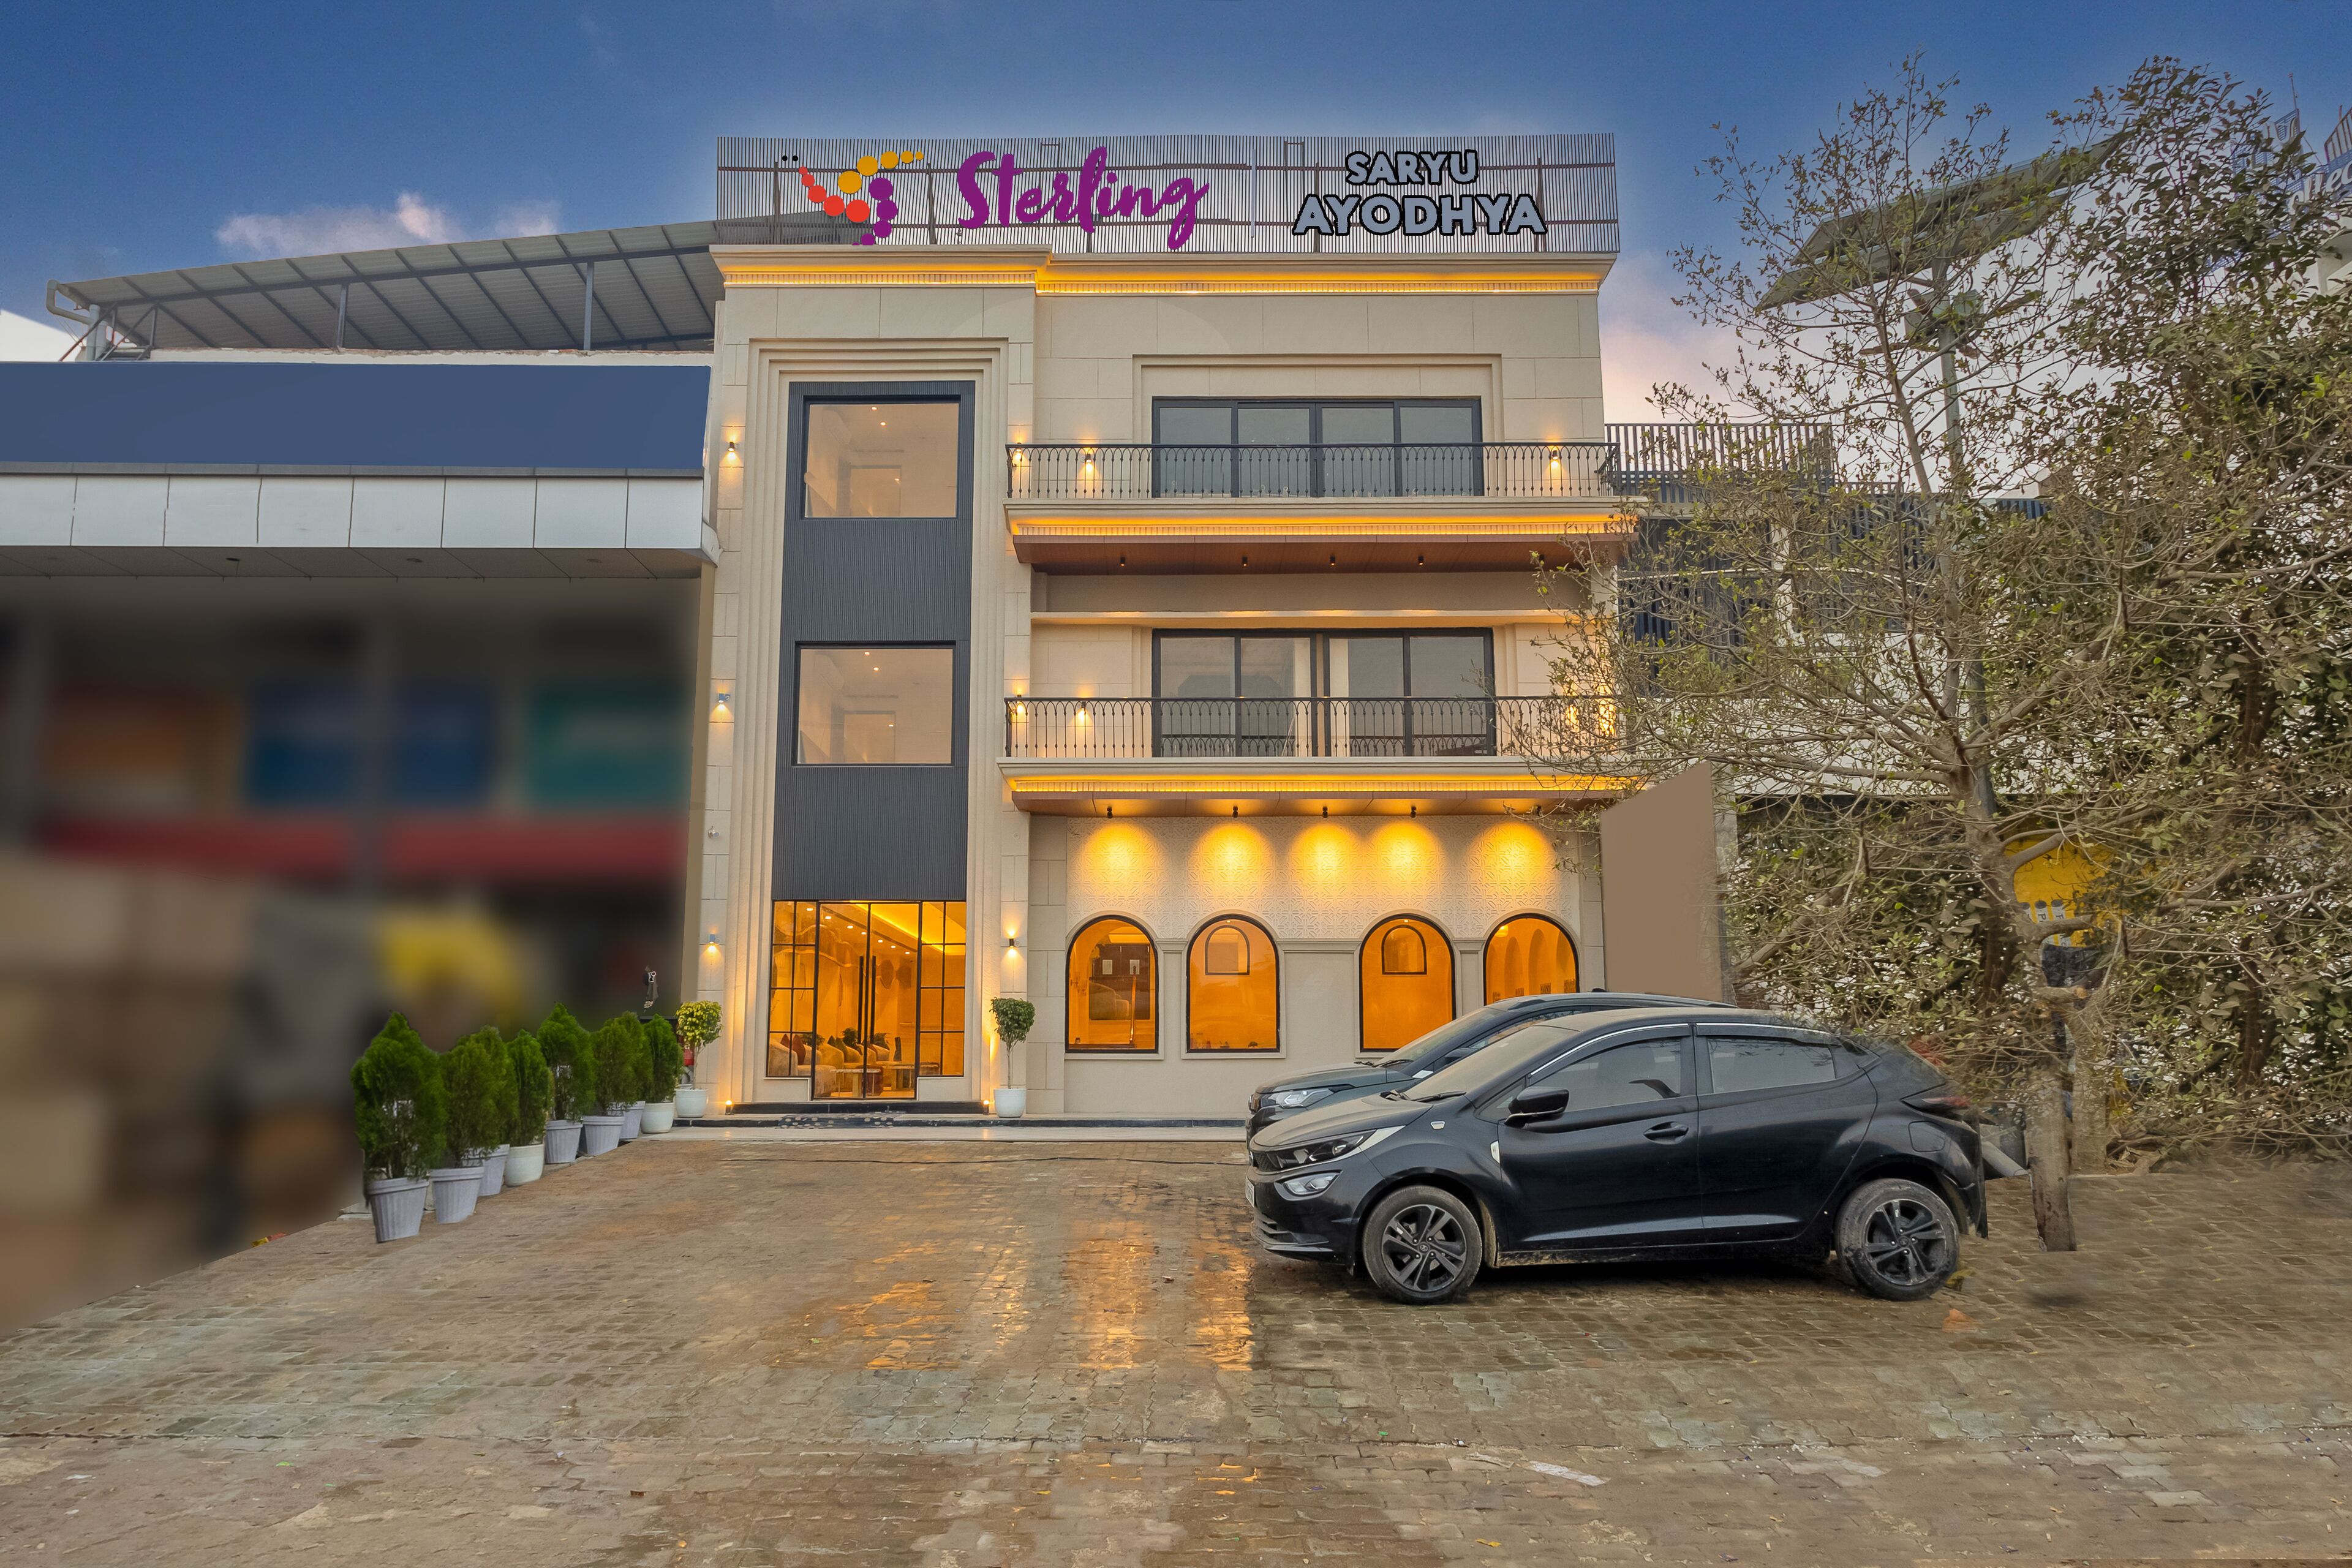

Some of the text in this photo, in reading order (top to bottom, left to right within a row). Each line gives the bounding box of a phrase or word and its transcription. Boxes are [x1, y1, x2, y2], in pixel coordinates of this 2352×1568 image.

[1345, 149, 1479, 186] SARYU
[957, 146, 1210, 250] Sterling
[1291, 193, 1548, 236] AYODHYA
